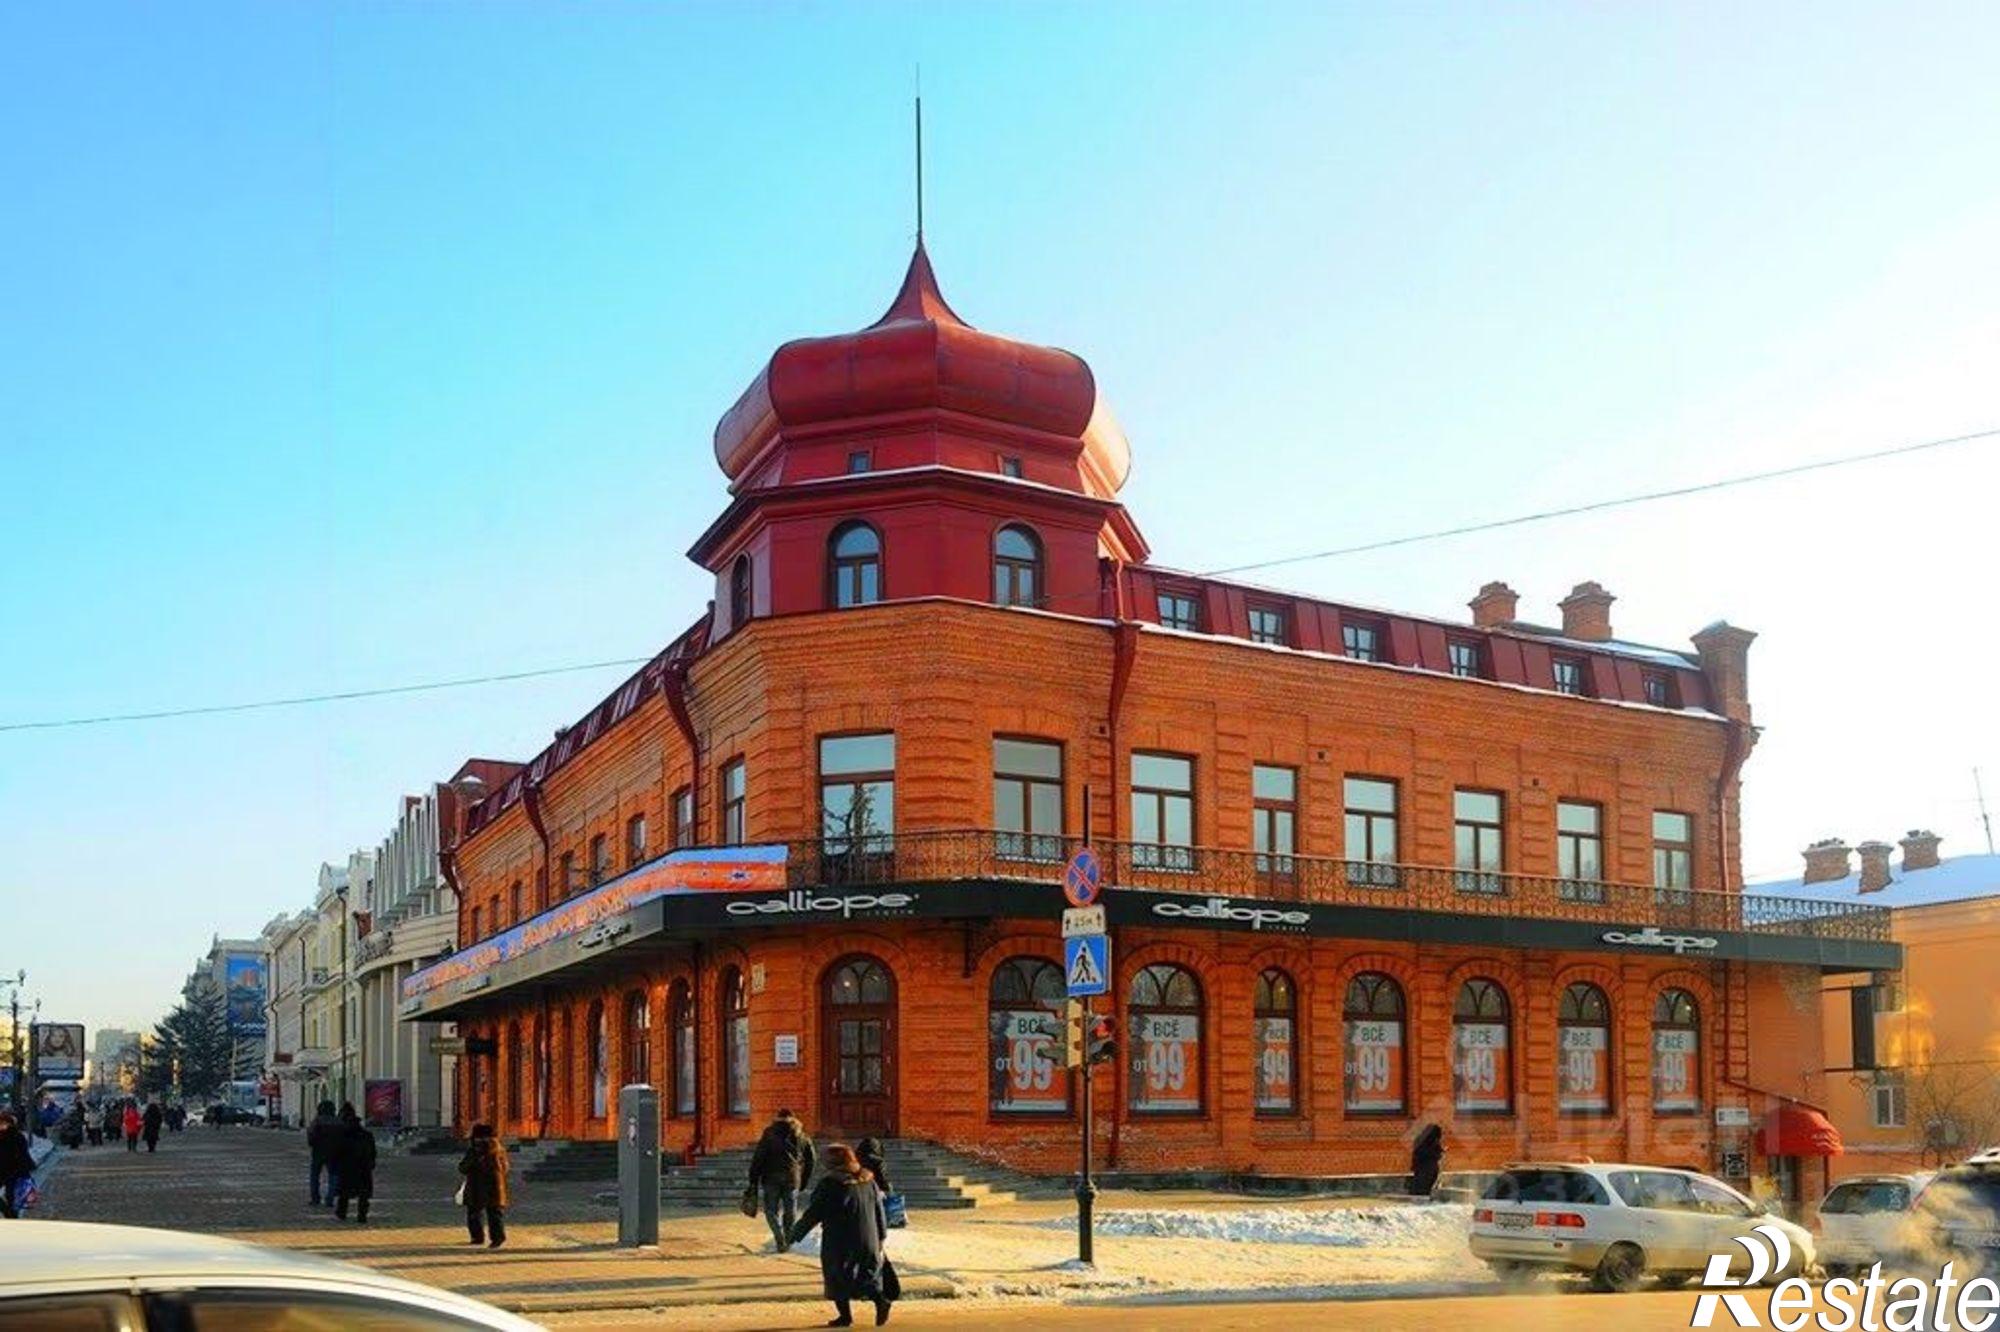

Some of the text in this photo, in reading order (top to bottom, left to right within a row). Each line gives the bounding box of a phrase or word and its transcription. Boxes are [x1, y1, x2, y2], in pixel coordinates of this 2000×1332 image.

[726, 890, 912, 919] calliope
[1152, 898, 1310, 930] calliope
[1602, 928, 1718, 954] calliope
[1150, 1041, 1185, 1091] 99
[1263, 1049, 1289, 1085] 99
[1358, 1047, 1389, 1092] 99
[1466, 1050, 1496, 1092] 99
[1570, 1050, 1595, 1092] 99
[1662, 1053, 1687, 1093] 99
